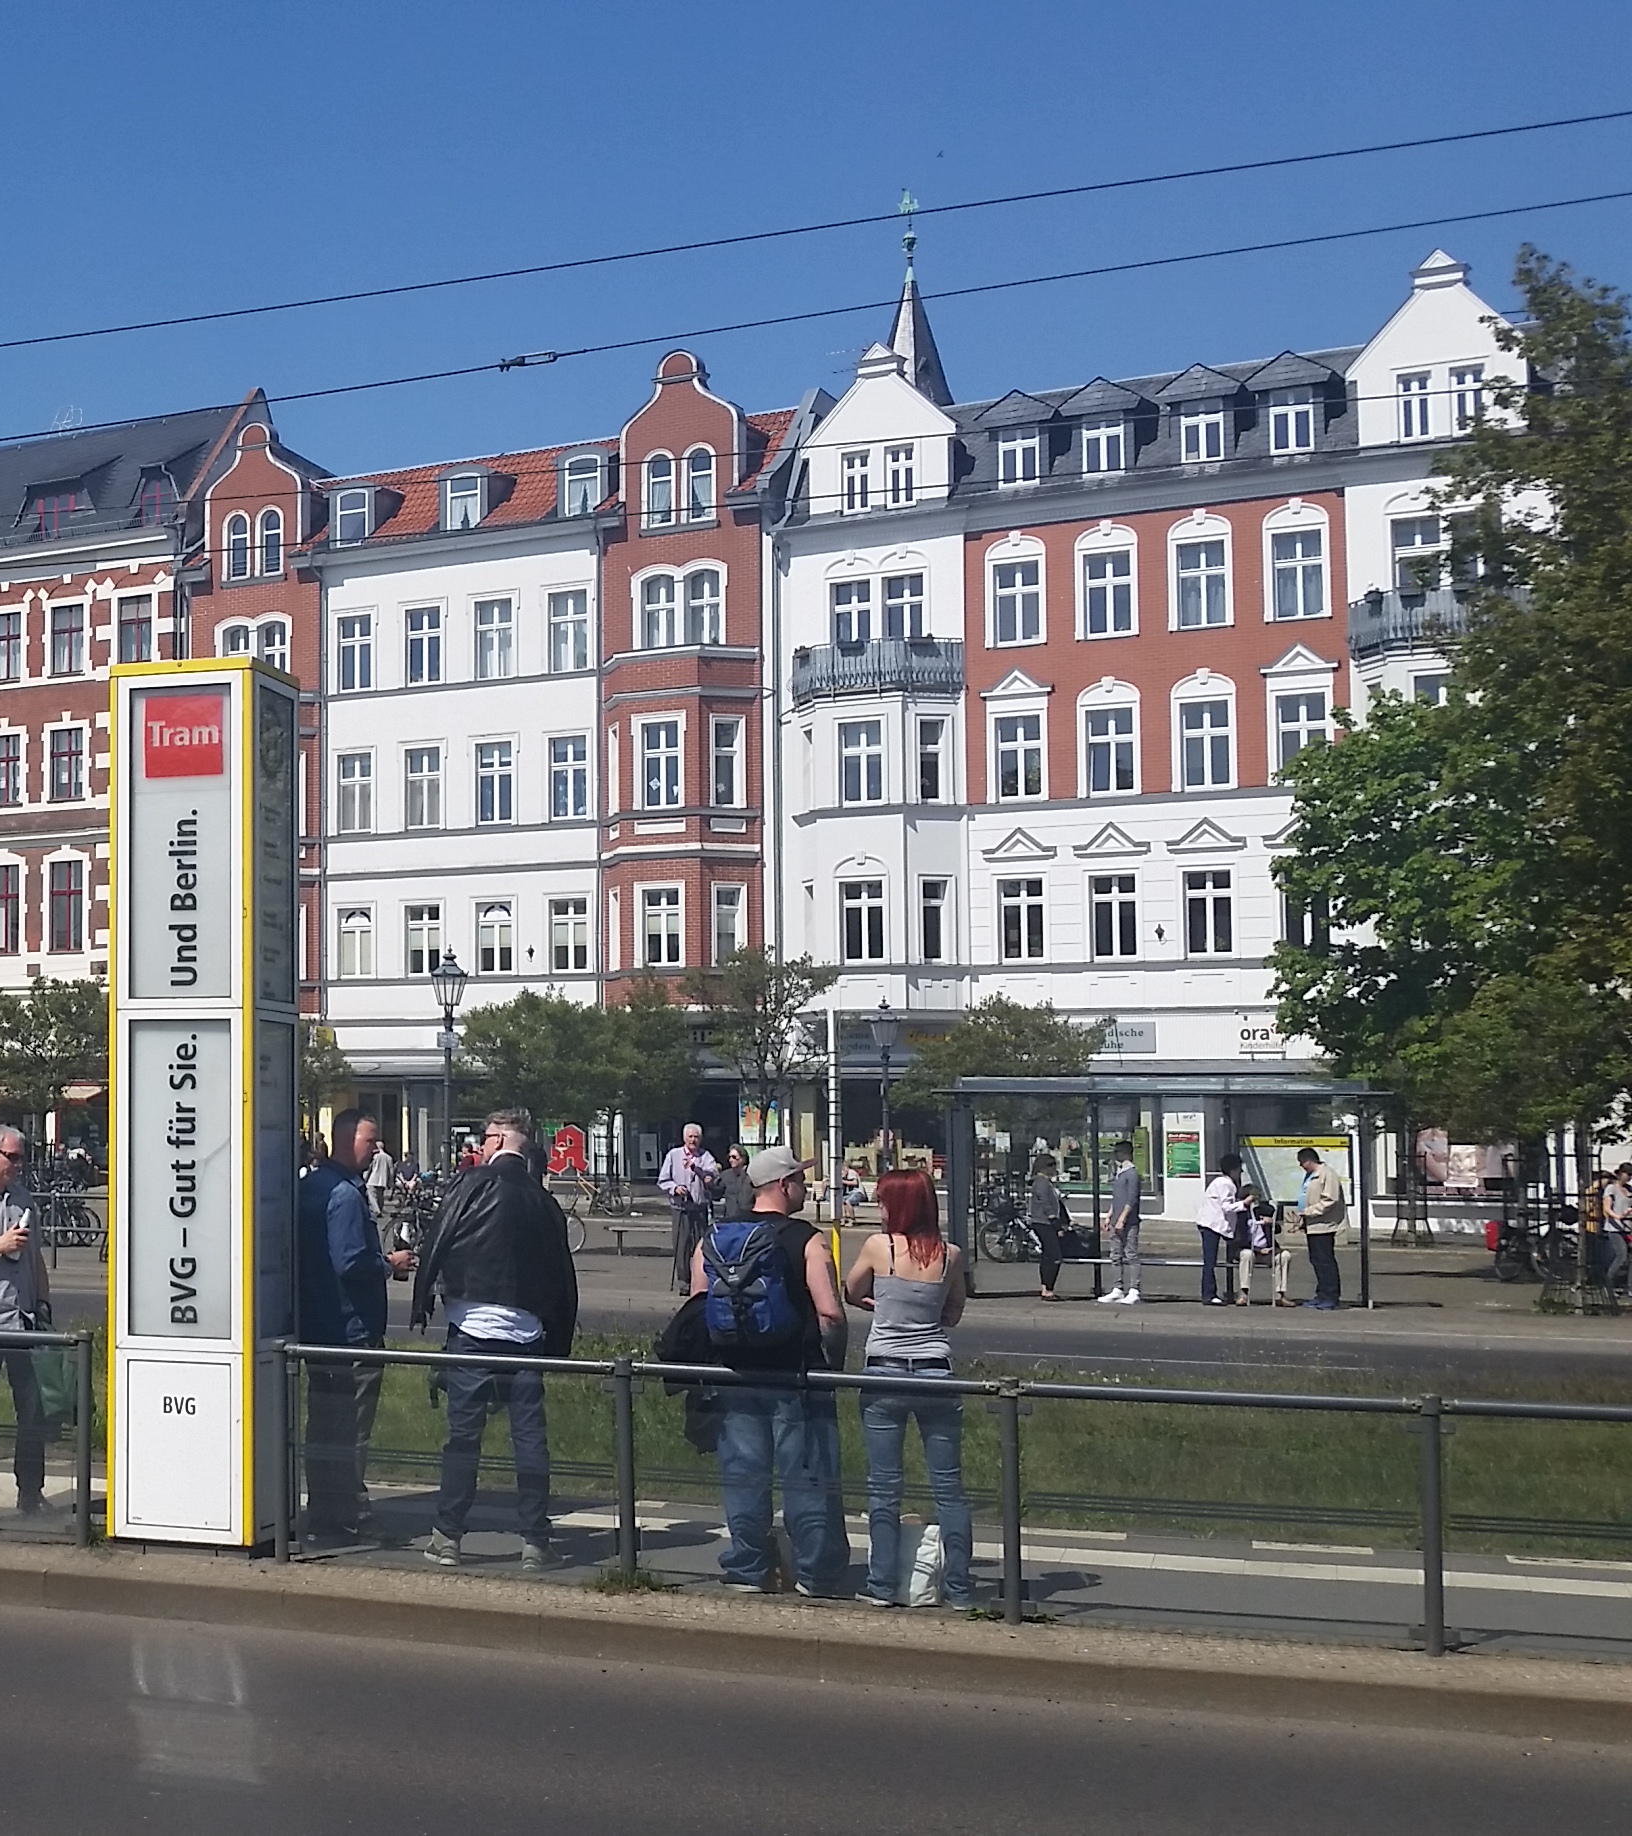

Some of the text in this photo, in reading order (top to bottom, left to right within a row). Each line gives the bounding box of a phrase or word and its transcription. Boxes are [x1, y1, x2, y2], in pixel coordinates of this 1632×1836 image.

[147, 720, 220, 748] Tram
[168, 808, 199, 987] Und Berlin.
[1240, 1028, 1270, 1041] ora
[168, 1033, 199, 1091] Sie.
[166, 1101, 197, 1148] für
[168, 1159, 197, 1218] Gut
[169, 1256, 198, 1325] BVG
[162, 1396, 197, 1415] BVG
